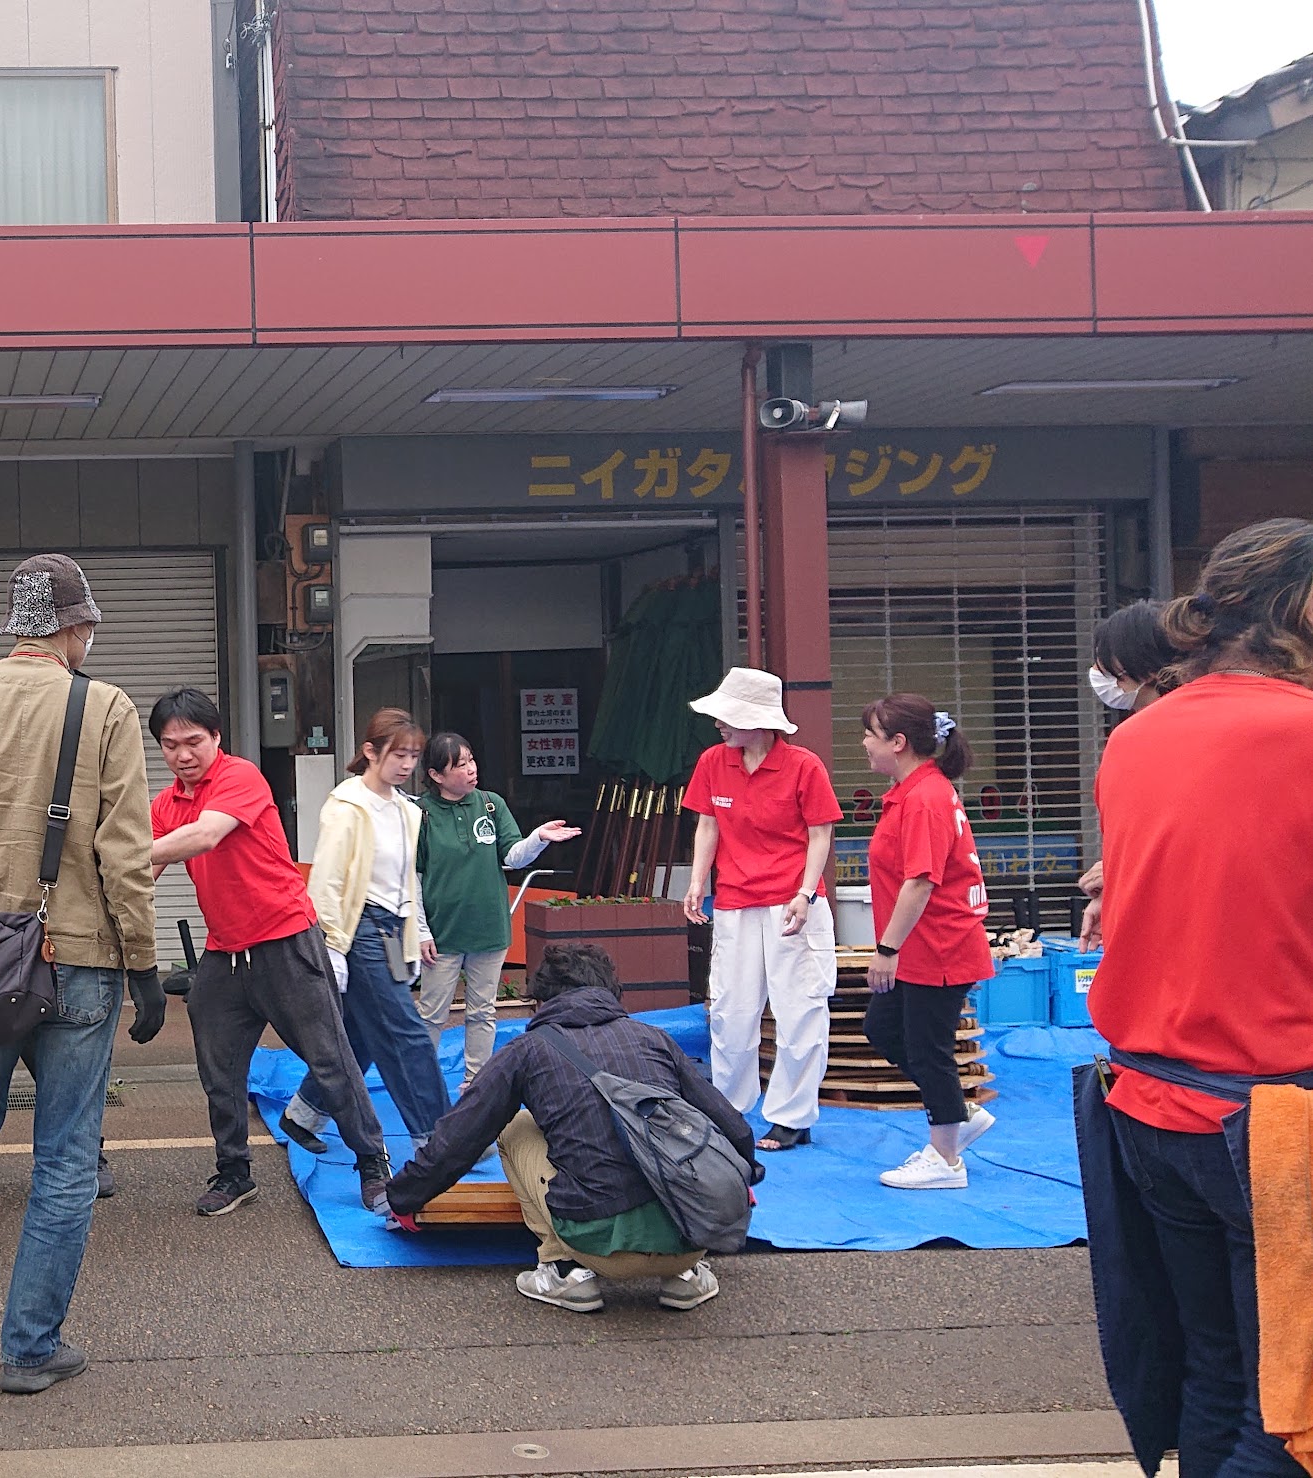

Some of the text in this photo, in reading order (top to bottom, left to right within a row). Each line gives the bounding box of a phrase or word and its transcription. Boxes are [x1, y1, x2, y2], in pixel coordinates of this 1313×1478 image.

[528, 443, 997, 499] ニイガタジング
[527, 737, 576, 751] 女性専用
